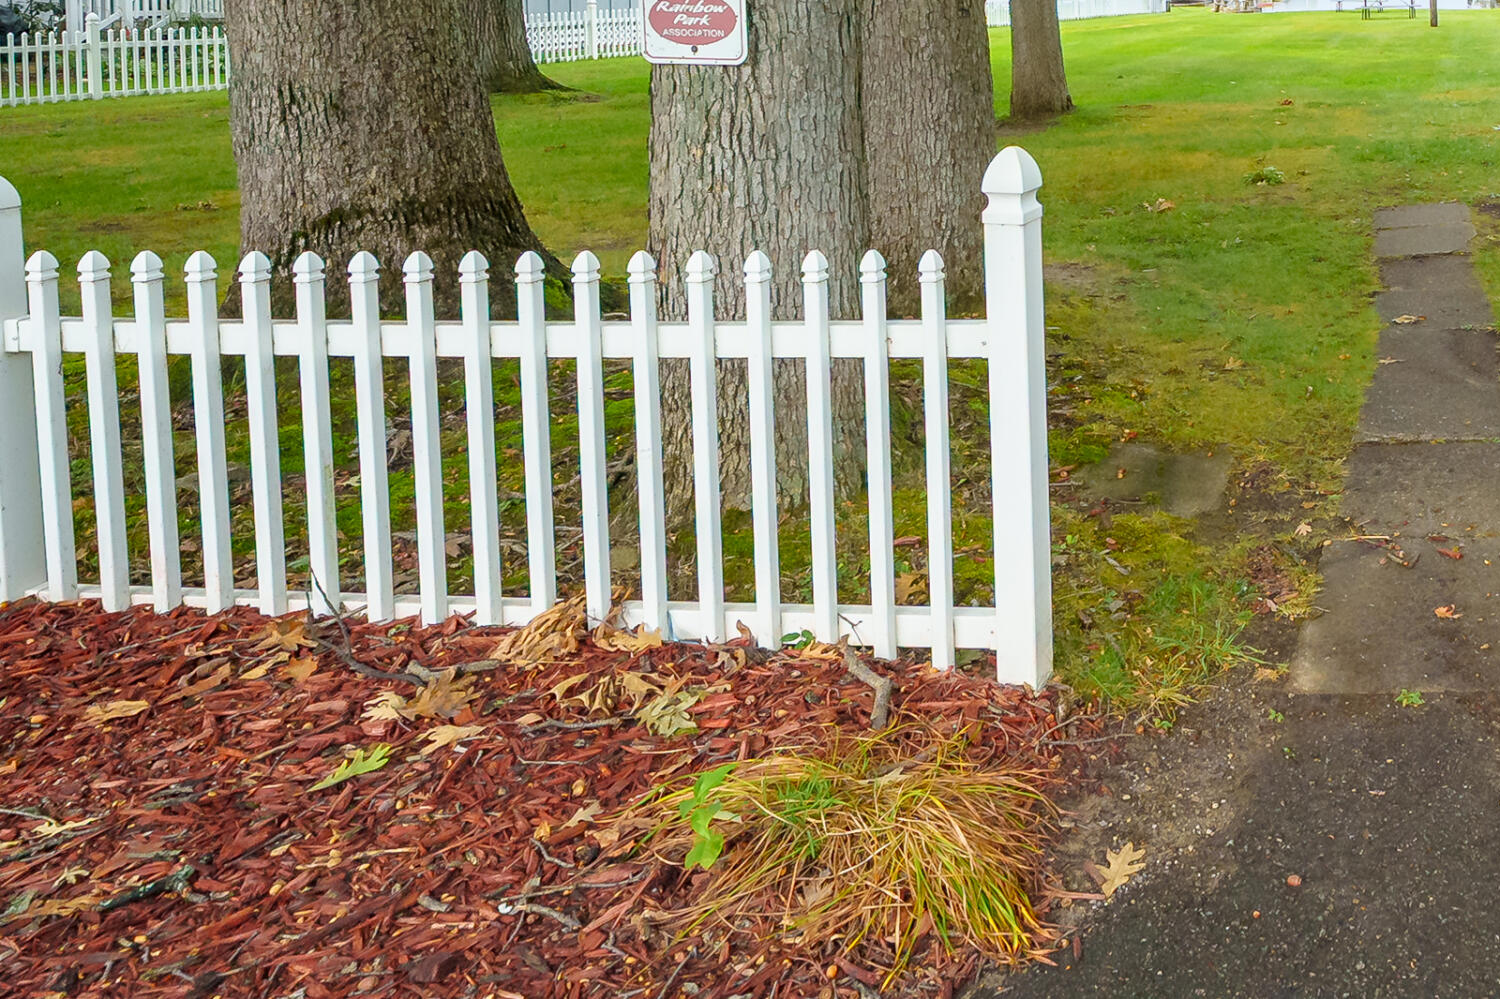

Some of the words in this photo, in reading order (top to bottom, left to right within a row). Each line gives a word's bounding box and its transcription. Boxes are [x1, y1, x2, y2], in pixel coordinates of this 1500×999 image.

[656, 0, 728, 13] Rainbow
[673, 14, 711, 26] Park
[662, 28, 725, 37] ASSOCIATION
